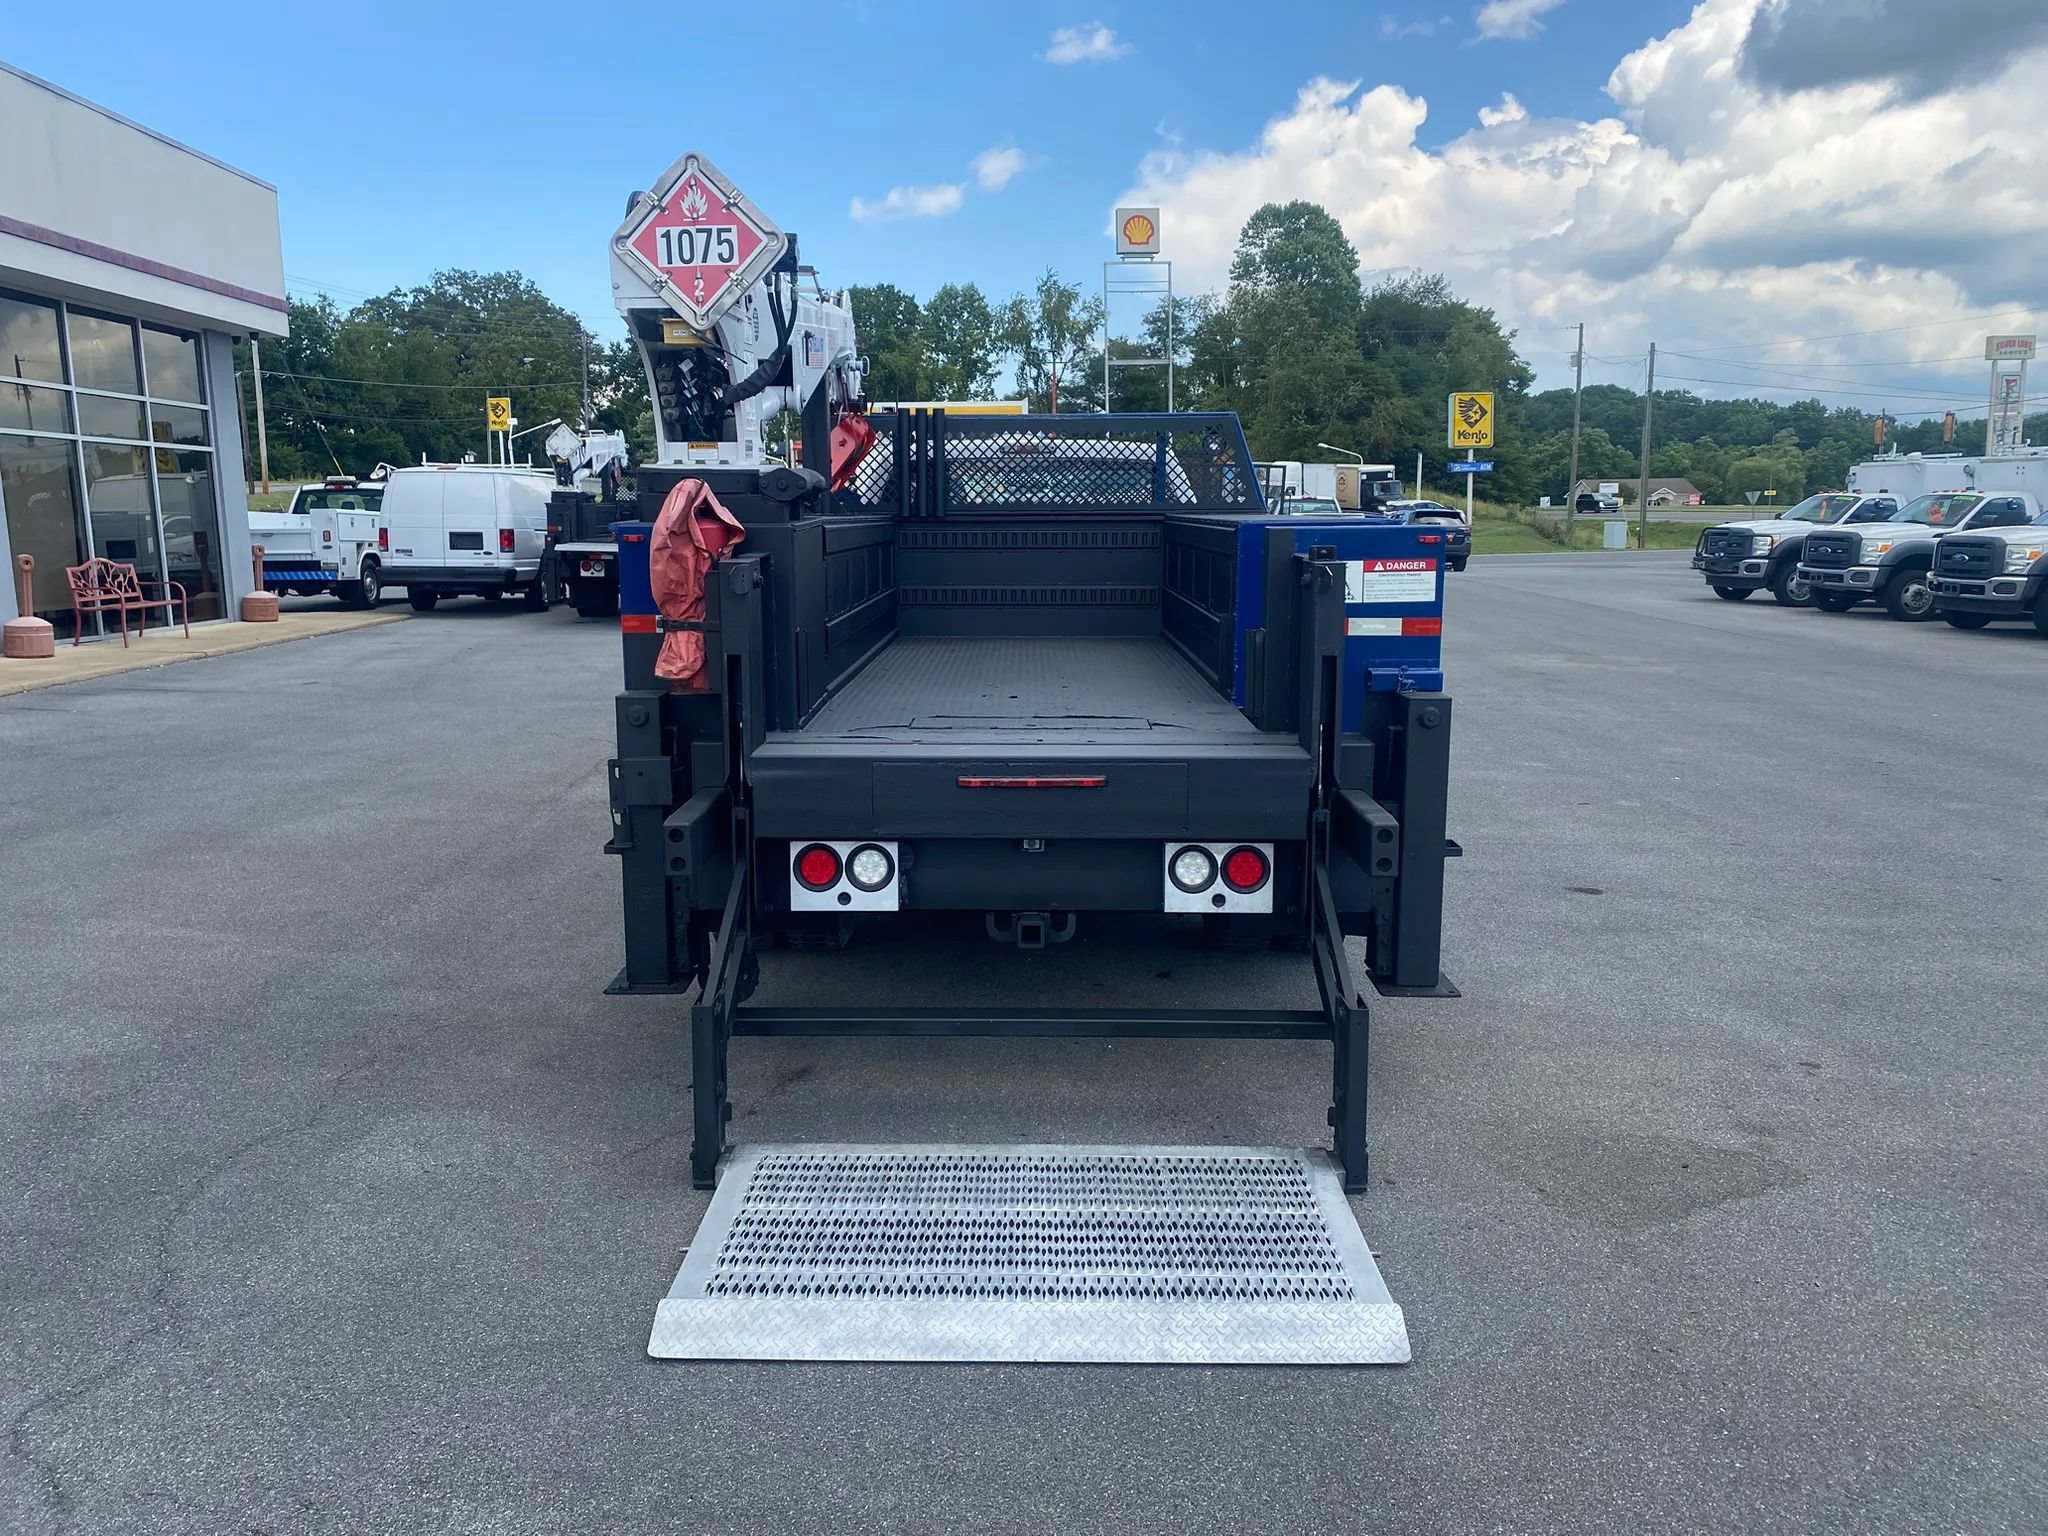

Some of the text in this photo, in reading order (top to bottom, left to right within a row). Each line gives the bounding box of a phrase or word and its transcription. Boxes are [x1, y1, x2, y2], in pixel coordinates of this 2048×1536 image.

[660, 227, 735, 265] 1075
[694, 279, 705, 296] 2
[1457, 430, 1488, 443] Kenjo
[1386, 561, 1426, 570] DANGER
